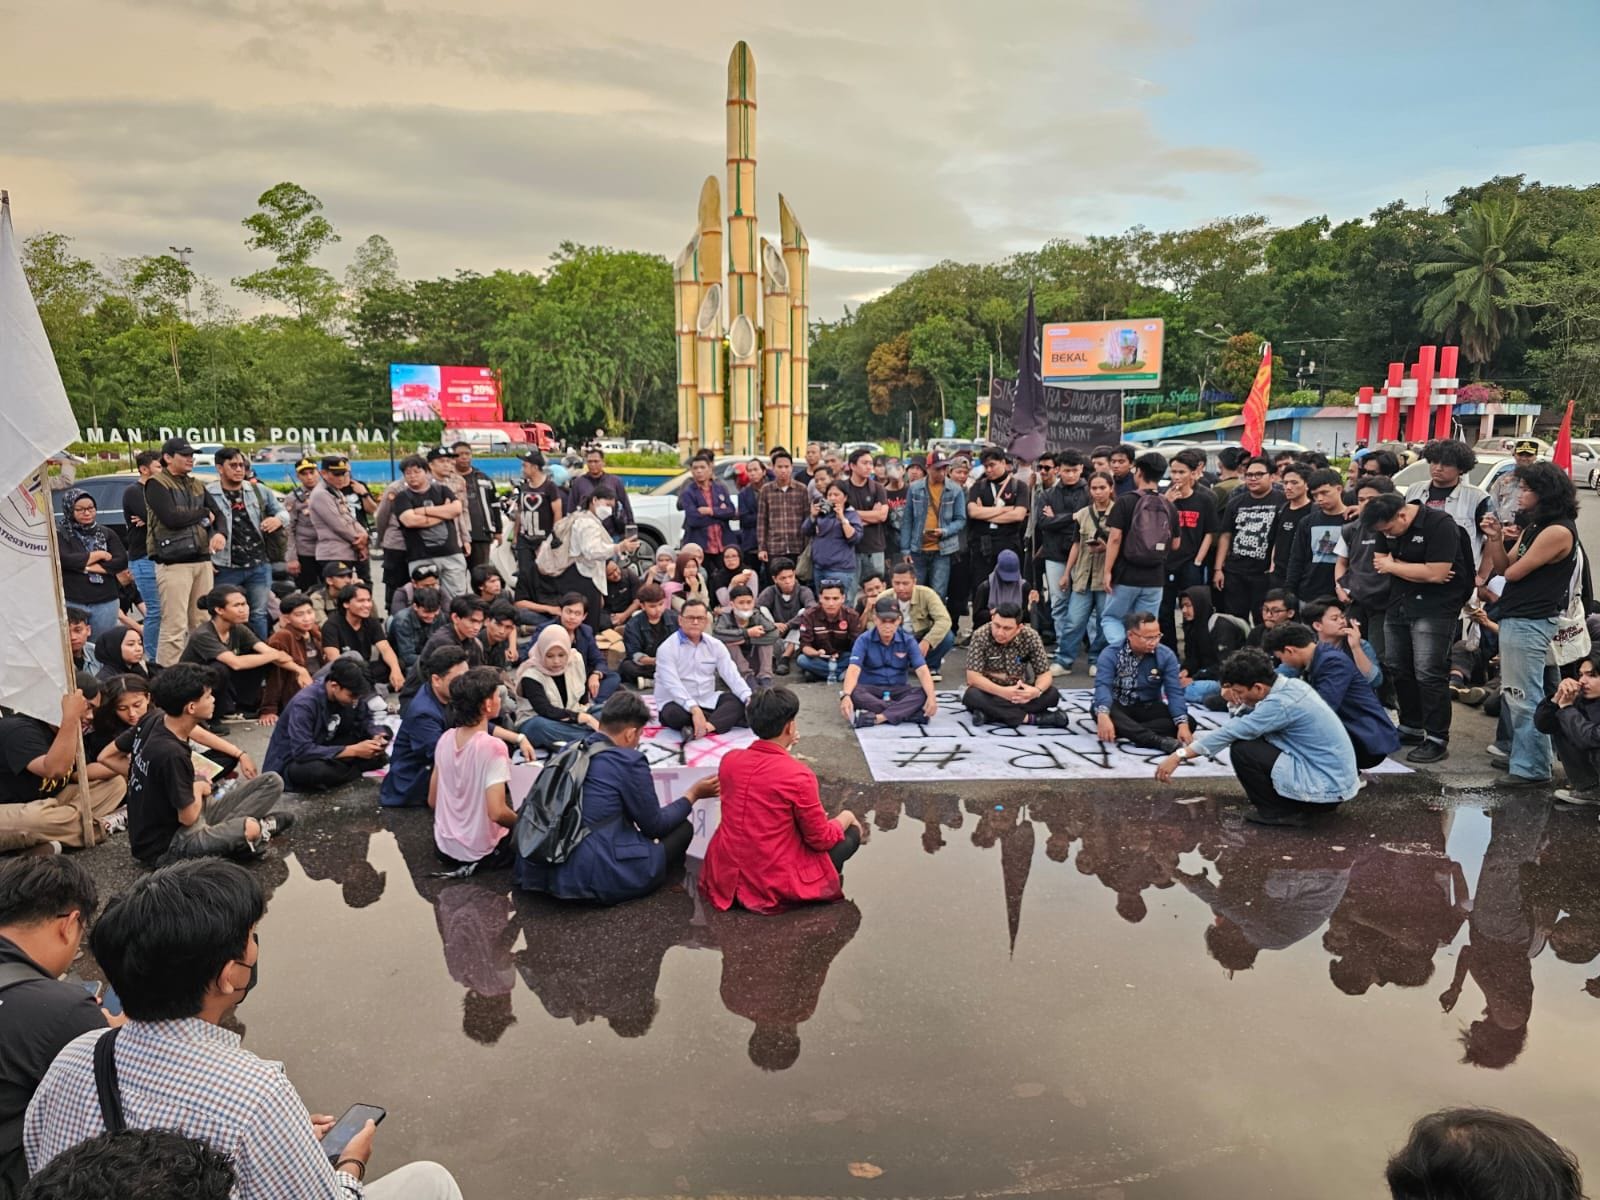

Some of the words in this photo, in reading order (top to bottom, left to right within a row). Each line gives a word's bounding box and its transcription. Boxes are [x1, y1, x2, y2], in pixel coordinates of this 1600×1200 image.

[1051, 352, 1088, 363] BEKAL
[78, 428, 142, 443] MAN
[160, 427, 256, 444] DIGULIS
